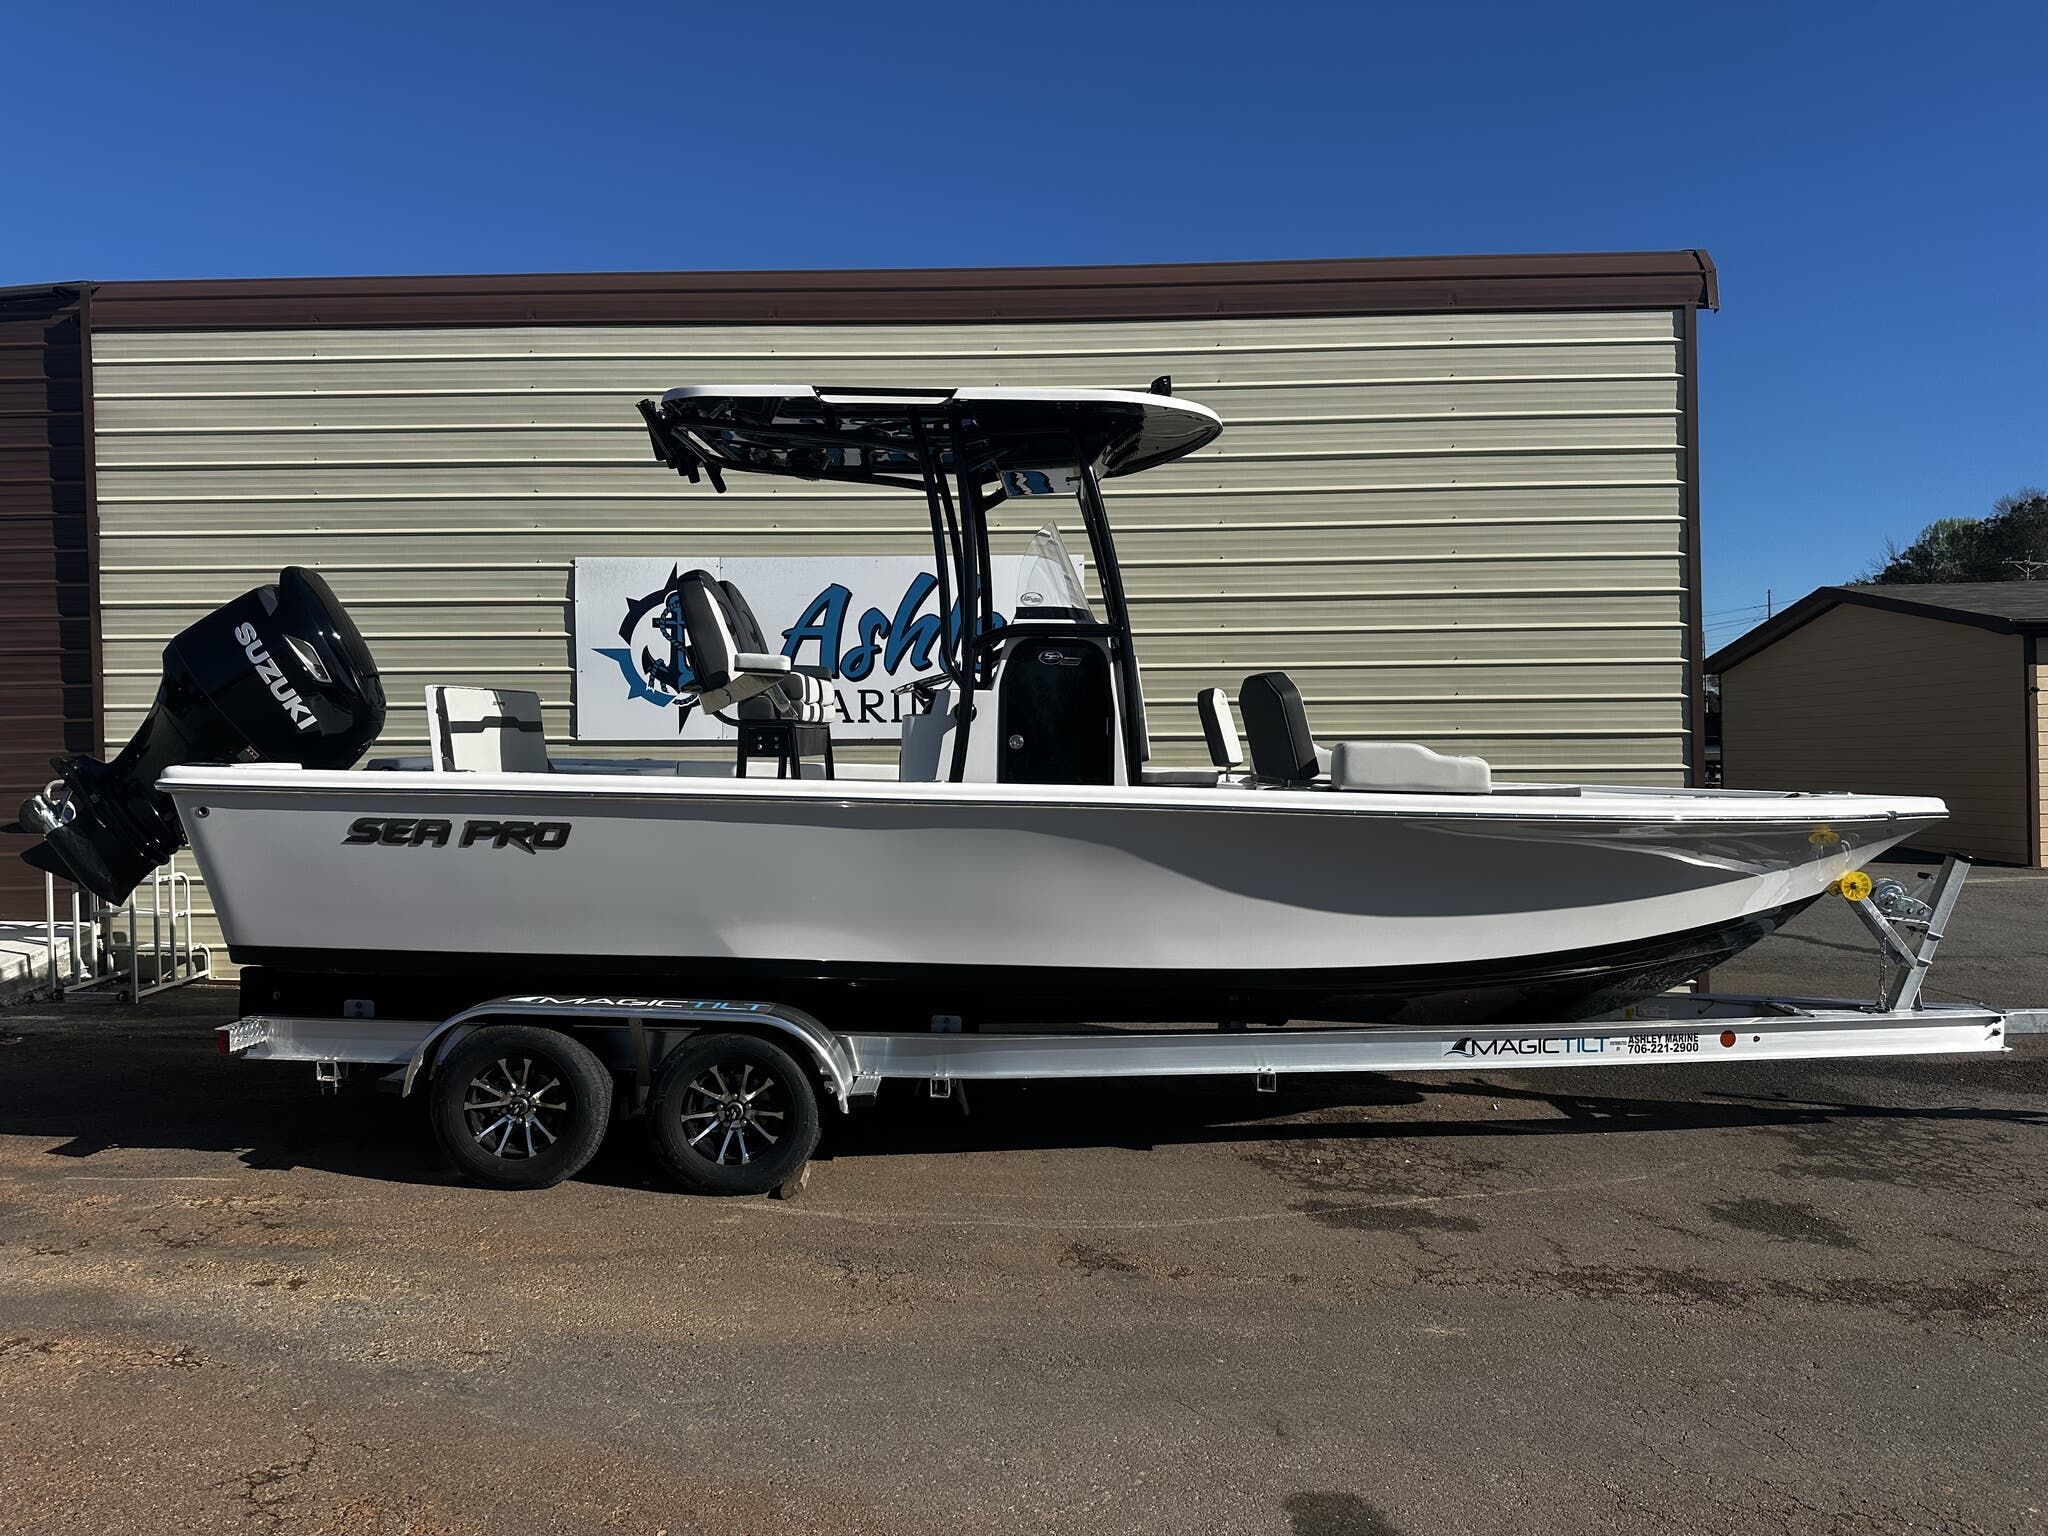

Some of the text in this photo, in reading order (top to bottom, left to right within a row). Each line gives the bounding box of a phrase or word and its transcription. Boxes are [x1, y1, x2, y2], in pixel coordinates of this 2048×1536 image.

[234, 622, 318, 730] SUZUKI
[340, 817, 572, 855] SEA PRO
[538, 997, 774, 1012] MAGICTILT
[1471, 1036, 1610, 1055] MAGICTILT
[1628, 1034, 1662, 1044] ASHLEY
[1665, 1032, 1699, 1043] MARINE
[1628, 1042, 1699, 1054] 706-221-2900
